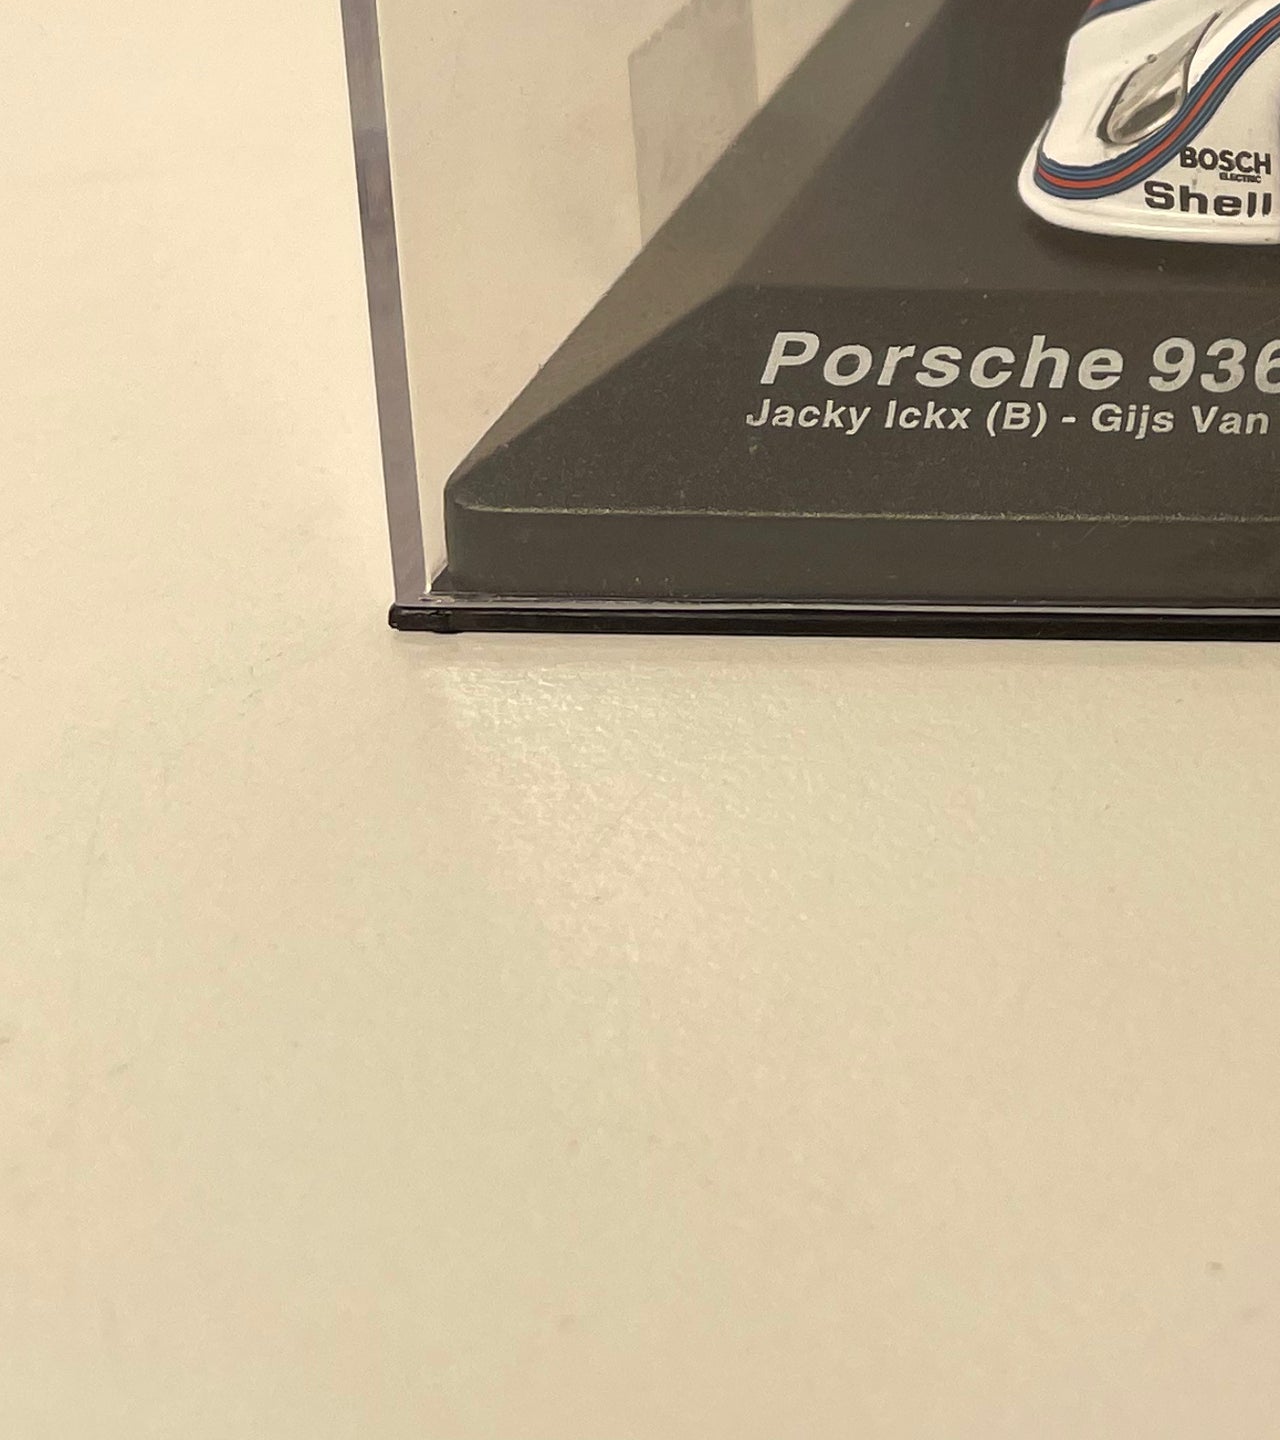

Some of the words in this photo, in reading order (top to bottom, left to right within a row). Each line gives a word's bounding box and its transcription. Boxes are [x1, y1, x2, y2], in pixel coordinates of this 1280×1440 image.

[1179, 146, 1272, 175] BOSCH
[1219, 172, 1262, 184] ELECTRIC
[1143, 180, 1272, 218] Shell
[760, 331, 1124, 391] Porsche
[745, 398, 872, 435] Jacky
[884, 400, 972, 430] Ickx
[986, 400, 1047, 438] (B)
[1091, 403, 1175, 440] Gijs
[1191, 405, 1269, 435] Van
